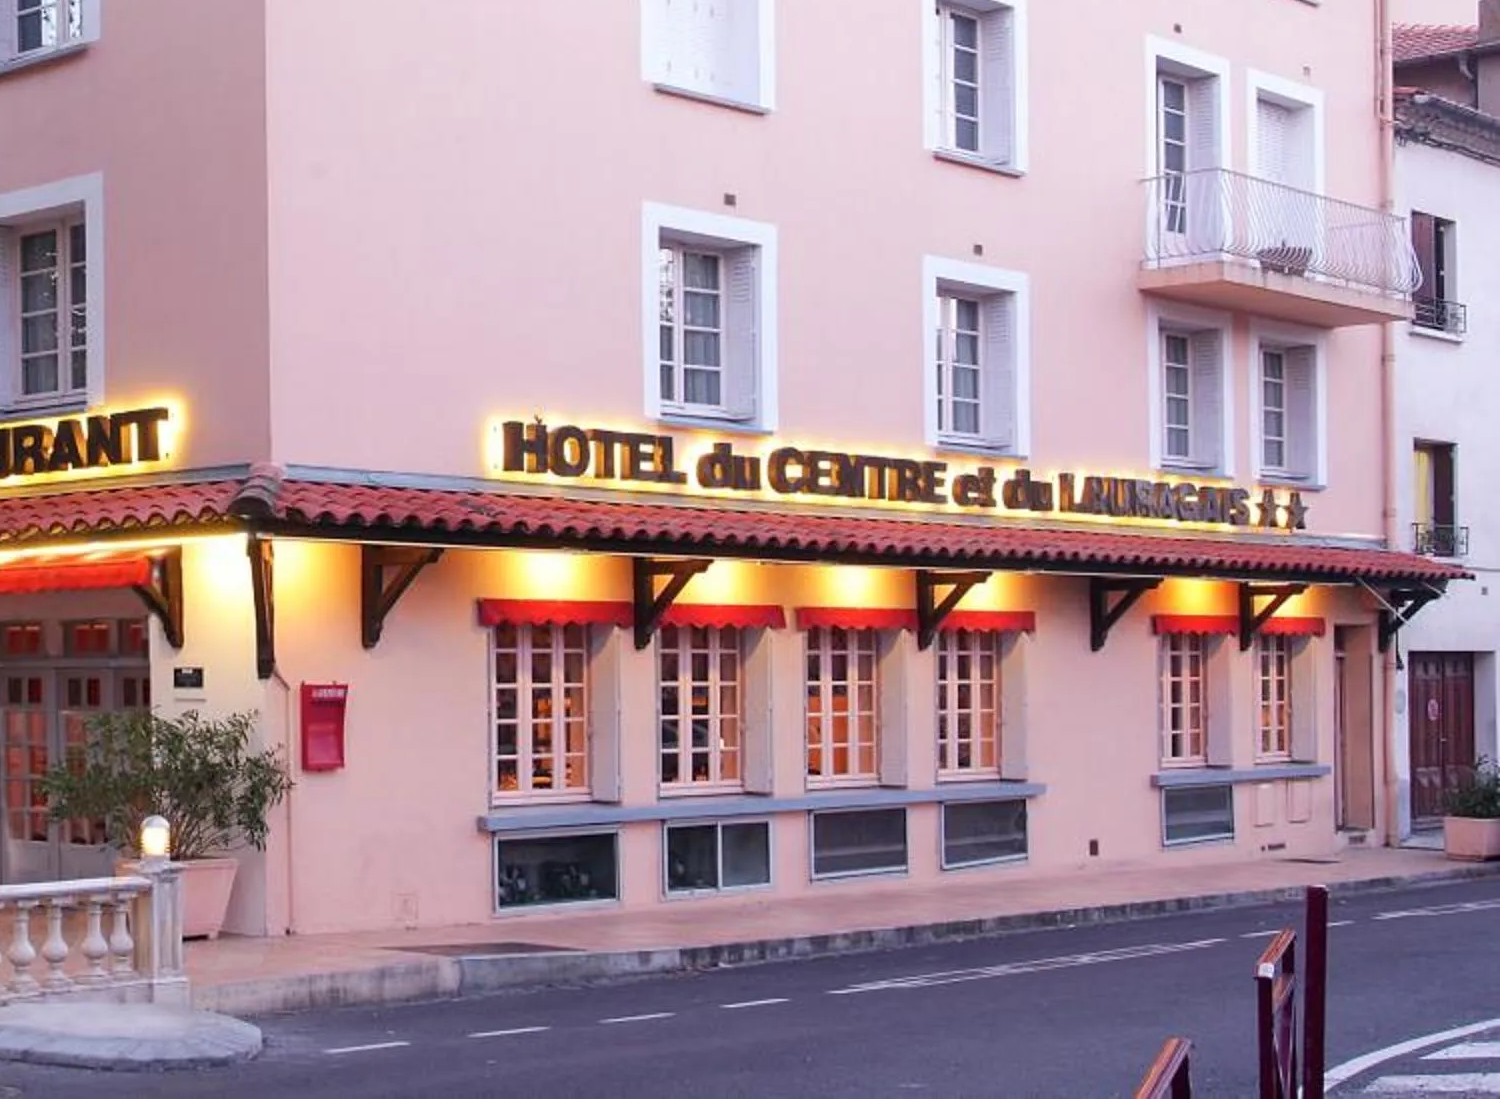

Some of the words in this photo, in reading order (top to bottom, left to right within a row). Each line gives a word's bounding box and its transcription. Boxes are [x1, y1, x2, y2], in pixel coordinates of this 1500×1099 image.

[502, 420, 688, 484] HOTEL
[697, 442, 761, 490] du
[768, 447, 948, 504] CENTRE
[952, 467, 996, 508] et
[1003, 469, 1054, 511] du
